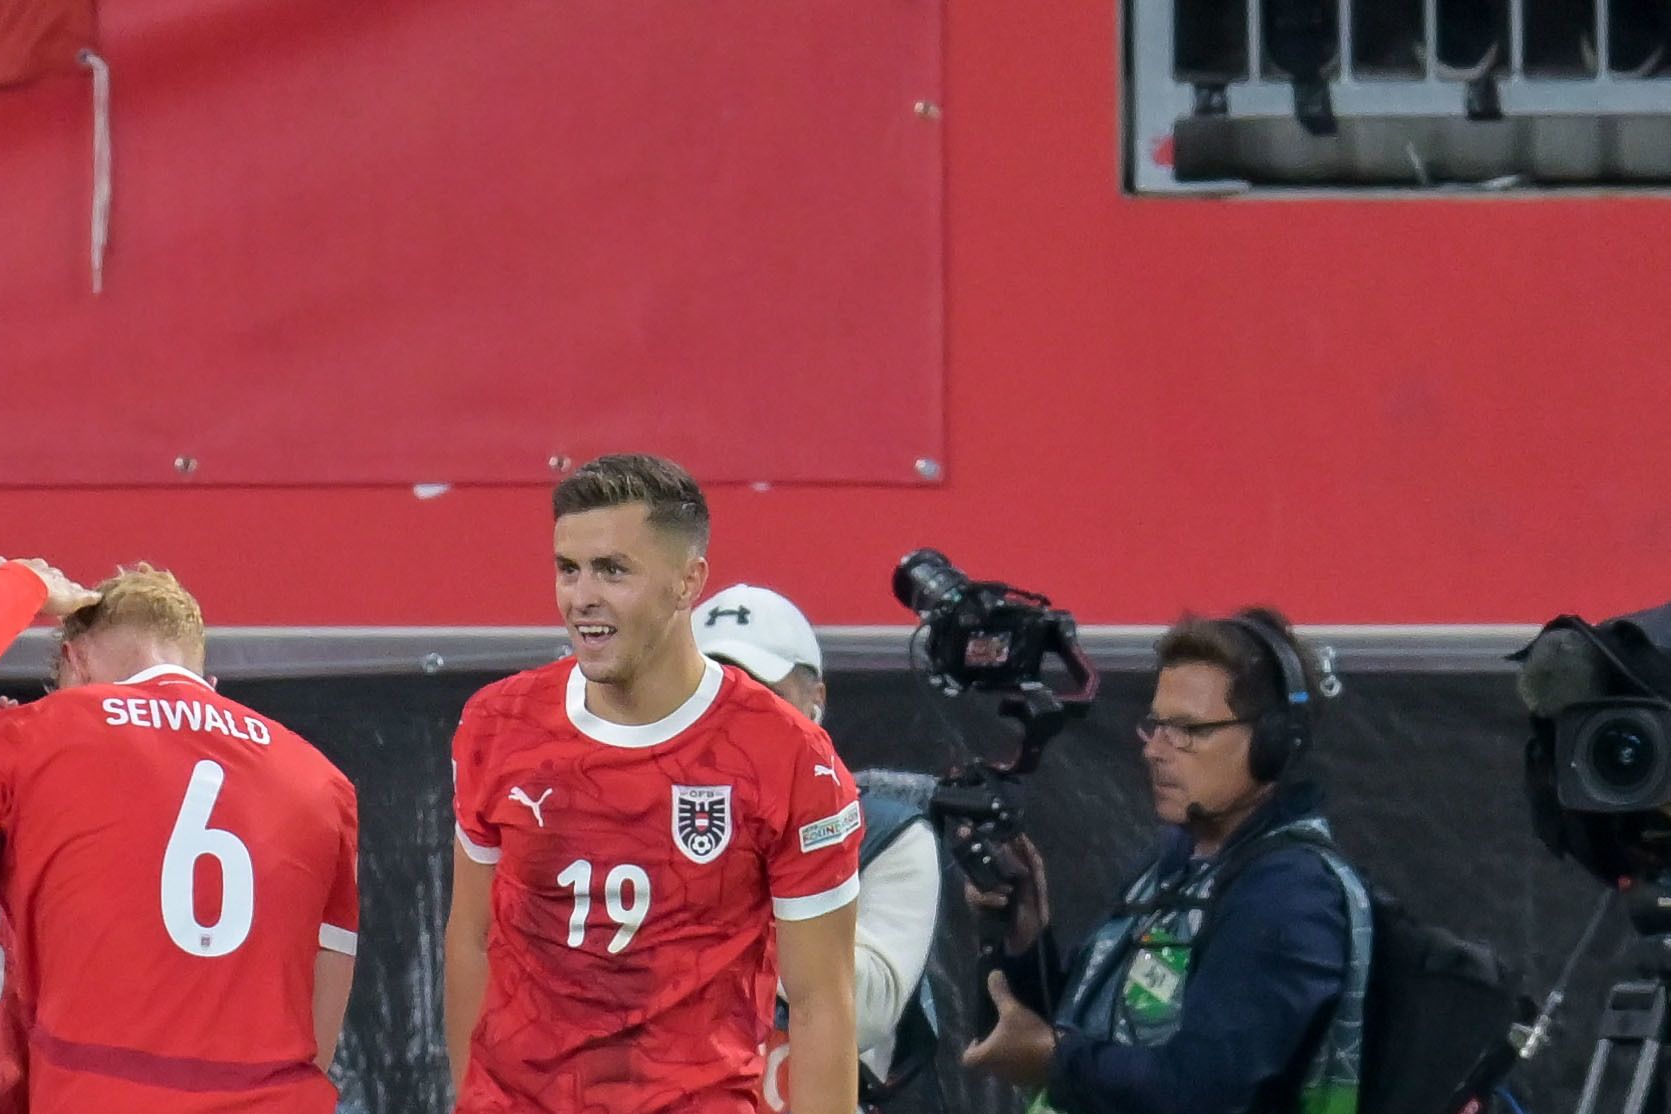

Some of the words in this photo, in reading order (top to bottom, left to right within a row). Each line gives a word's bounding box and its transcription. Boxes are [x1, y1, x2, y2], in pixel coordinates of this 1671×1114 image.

[102, 697, 271, 746] SEIWALD
[160, 759, 255, 957] 6
[556, 858, 652, 955] 19
